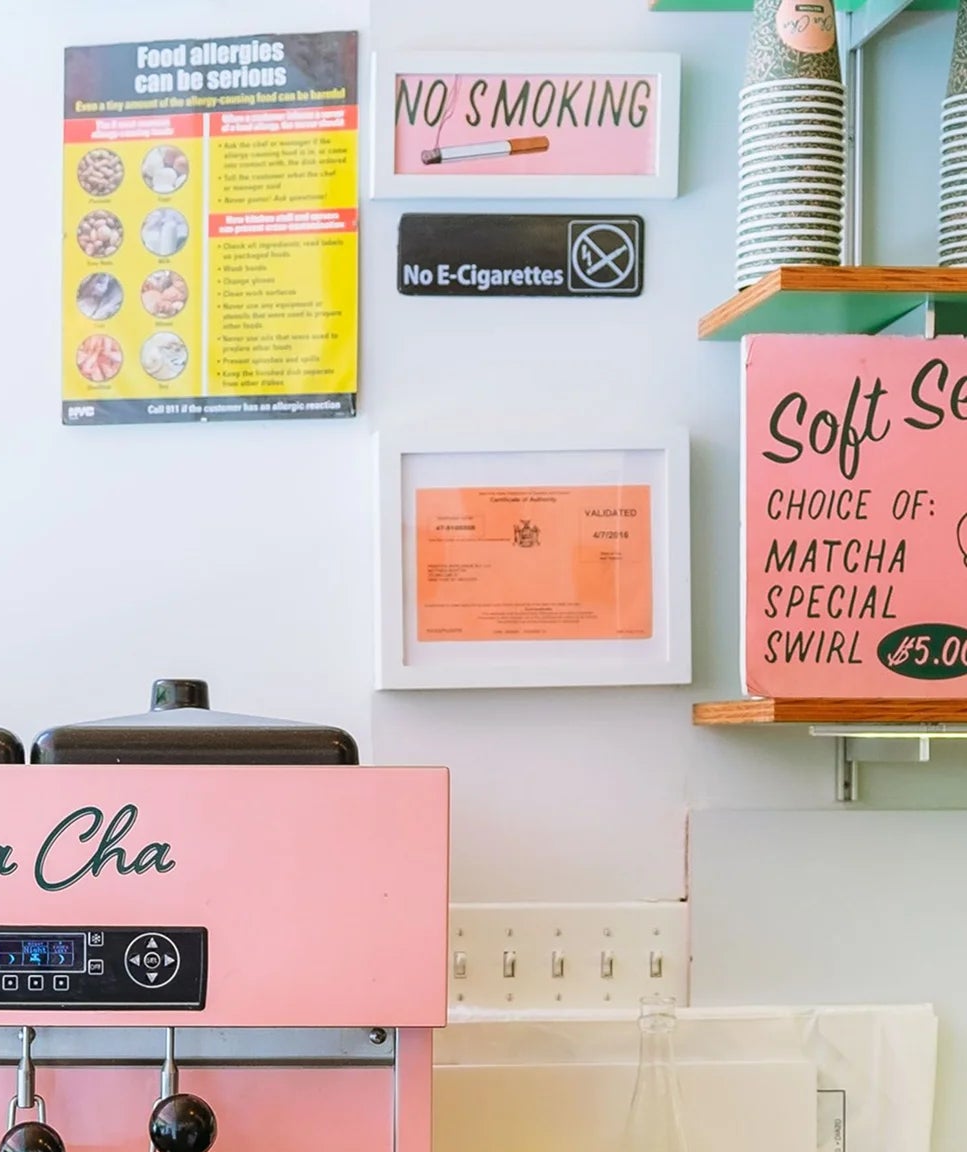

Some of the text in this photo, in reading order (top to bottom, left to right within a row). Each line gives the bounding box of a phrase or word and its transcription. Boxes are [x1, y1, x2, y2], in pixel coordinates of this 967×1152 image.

[137, 40, 284, 69] Food allergies
[135, 66, 287, 94] can be serious
[75, 101, 98, 112] Even
[256, 91, 278, 103] food
[278, 91, 296, 103] can
[296, 90, 310, 101] be
[395, 79, 651, 129] NO SMOKING
[403, 264, 565, 291] No E-Cigarettes
[147, 400, 341, 415] Call 911 if the customer has an allergic reaction
[762, 358, 967, 481] Soft Se
[584, 508, 637, 517] VALIDATED
[767, 489, 935, 521] CHOICE OF:
[764, 539, 907, 573] MATCHA
[764, 585, 897, 619] SPECIAL
[764, 630, 863, 664] SWIRL
[34, 804, 176, 892] Cha
